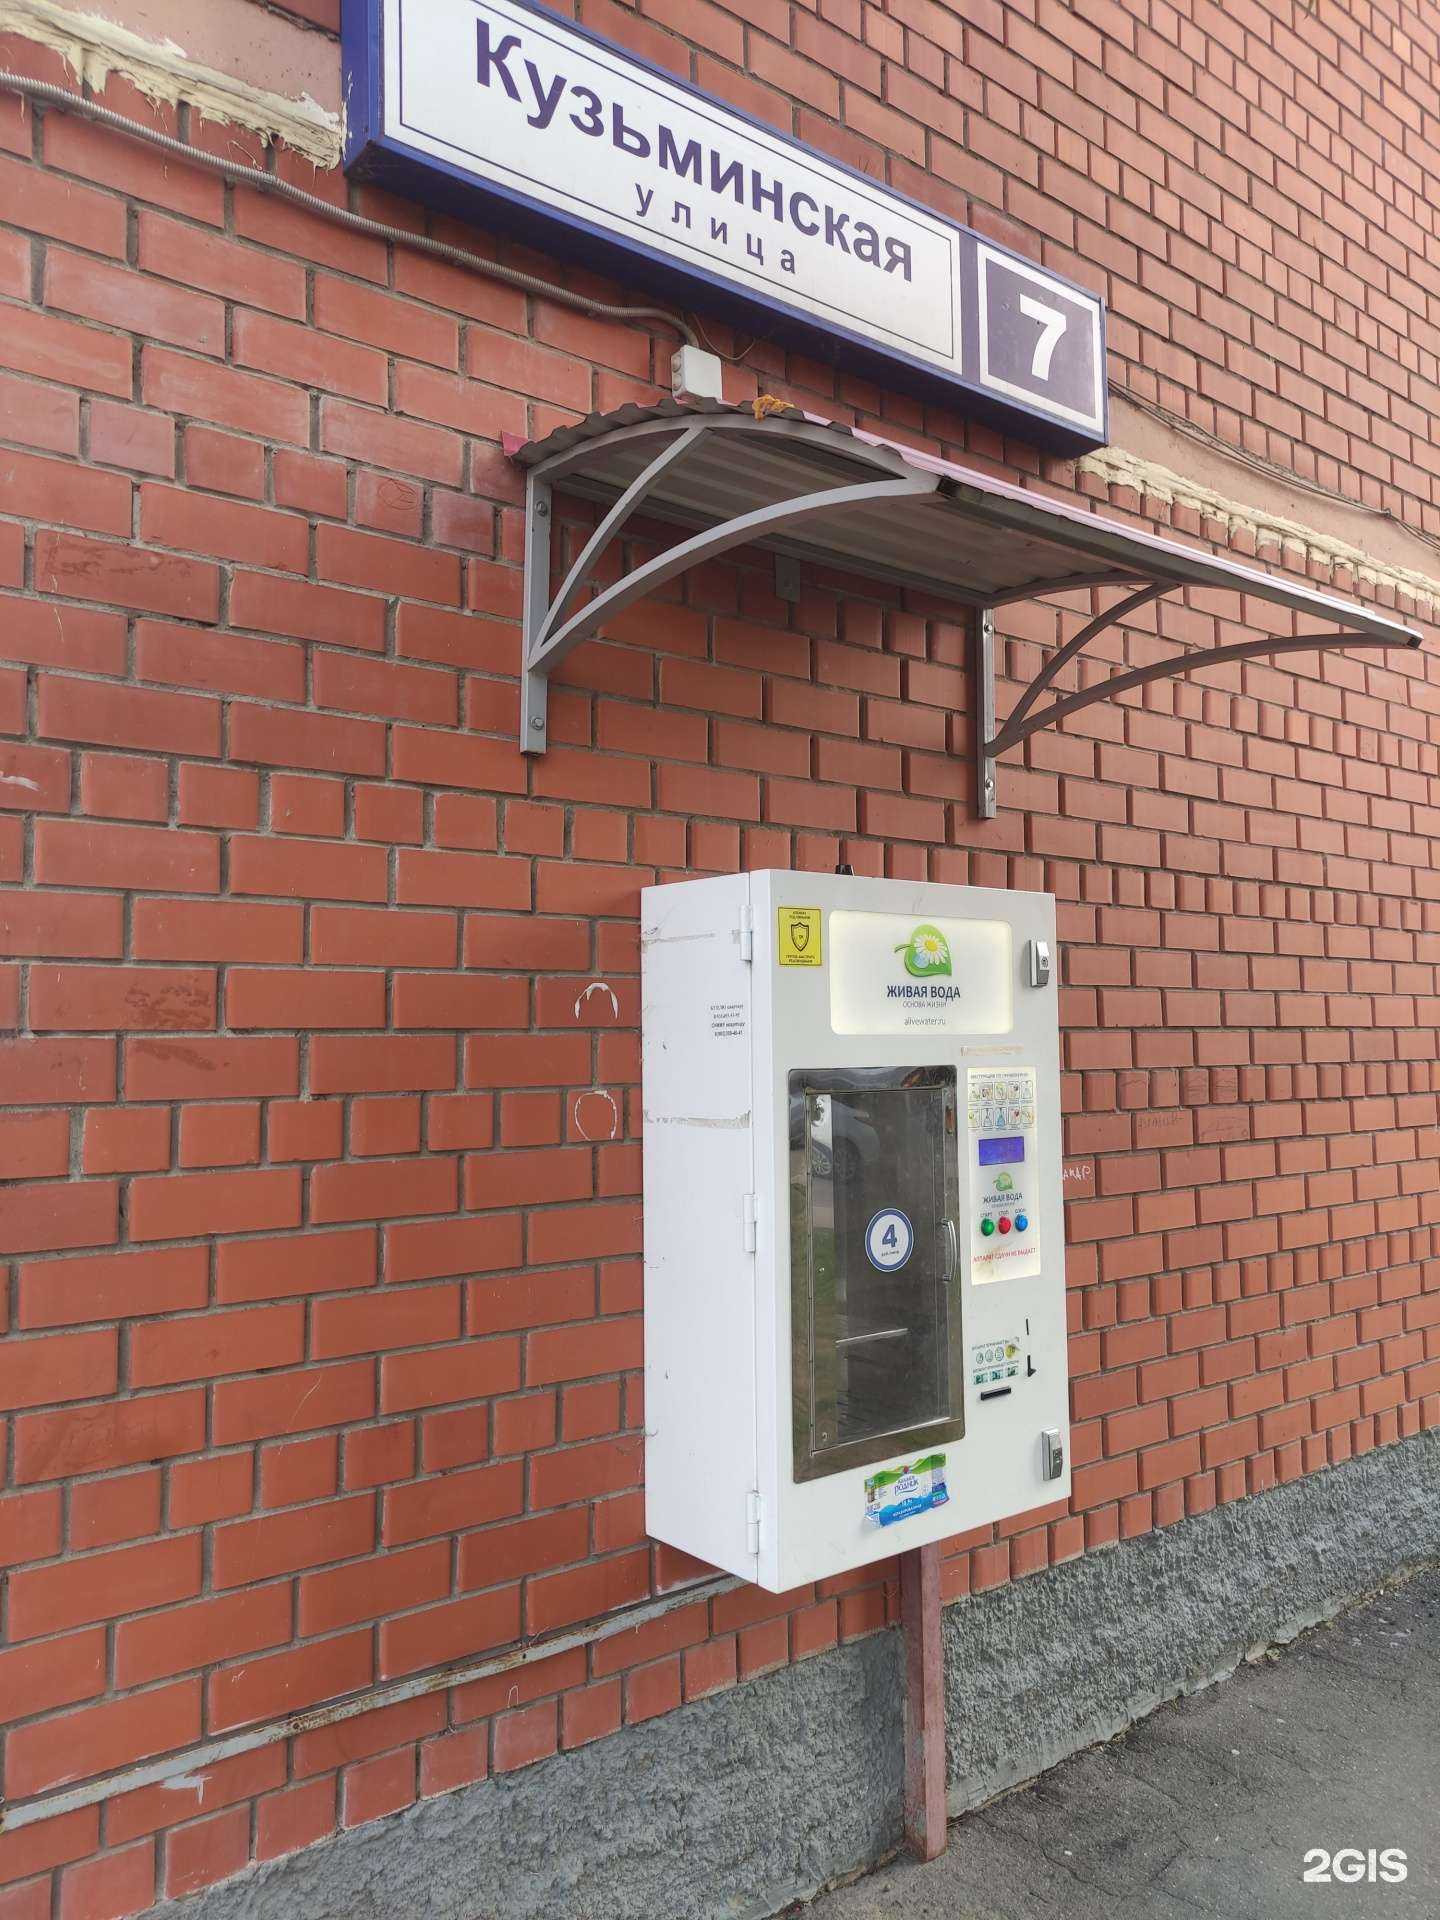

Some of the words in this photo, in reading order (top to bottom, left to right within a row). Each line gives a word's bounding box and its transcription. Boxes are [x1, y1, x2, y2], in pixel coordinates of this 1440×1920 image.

[475, 18, 912, 283] Кузьминская
[634, 183, 797, 275] улица
[1019, 294, 1067, 382] 7
[887, 985, 928, 998] ЖИВАЯ
[930, 985, 961, 1001] ВОДА
[904, 1016, 946, 1026] alivewater.ru
[882, 1224, 897, 1248] 4
